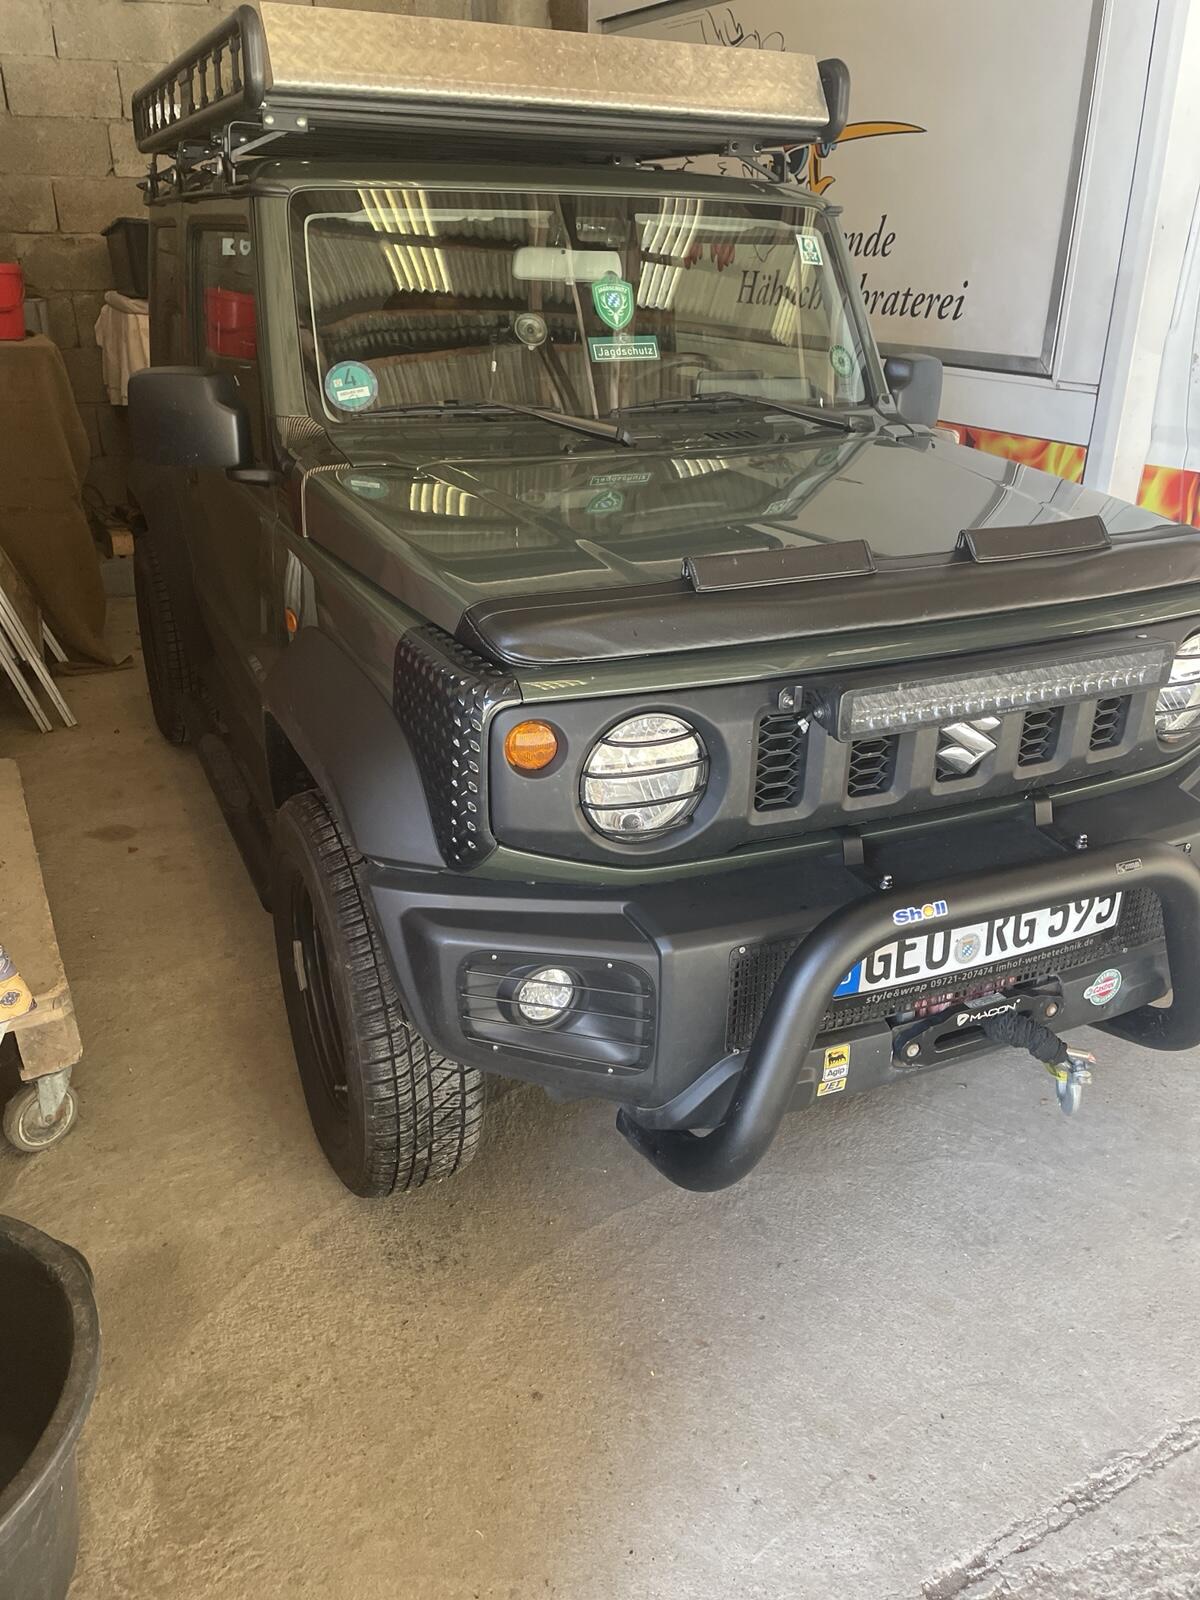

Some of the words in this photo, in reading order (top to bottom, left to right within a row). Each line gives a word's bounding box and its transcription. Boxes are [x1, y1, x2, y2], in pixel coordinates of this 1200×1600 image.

[844, 214, 896, 257] nde
[598, 346, 654, 359] Jagdschutz
[984, 914, 1037, 957] RG
[866, 982, 928, 1004] style&wrap
[930, 965, 993, 988] 09721-207474
[995, 938, 1094, 973] imhof-werbetechnik.de
[820, 1080, 842, 1092] JET
[827, 1066, 845, 1078] Agip
